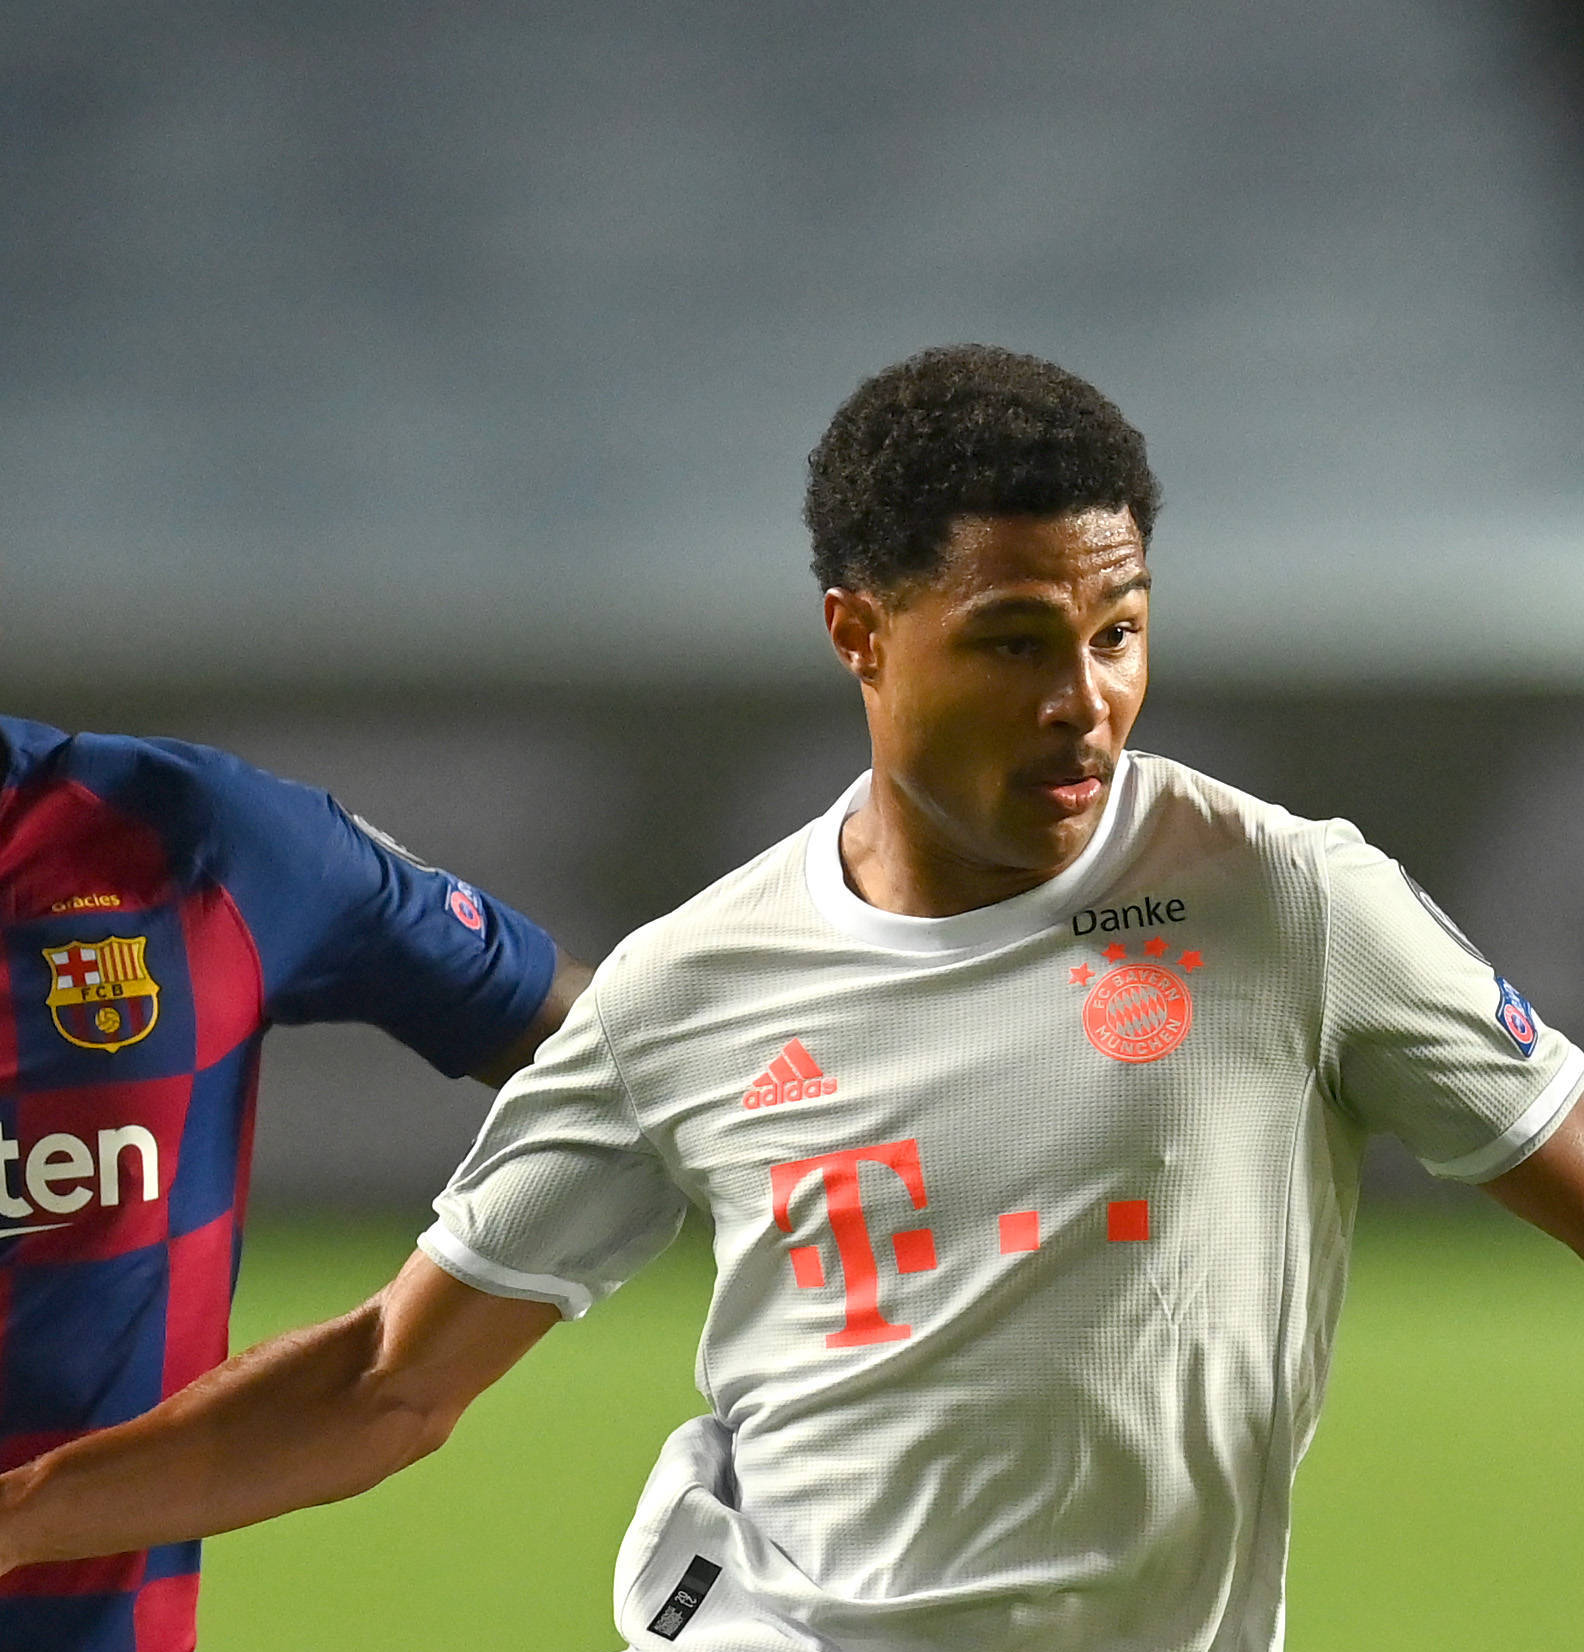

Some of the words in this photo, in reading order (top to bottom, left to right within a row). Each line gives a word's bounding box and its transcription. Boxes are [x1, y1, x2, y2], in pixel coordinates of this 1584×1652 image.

[1072, 896, 1186, 936] Danke
[81, 984, 124, 1001] FCB
[1094, 988, 1111, 1009] FC
[1112, 970, 1182, 1001] BAYERN
[742, 1076, 838, 1110] adidas
